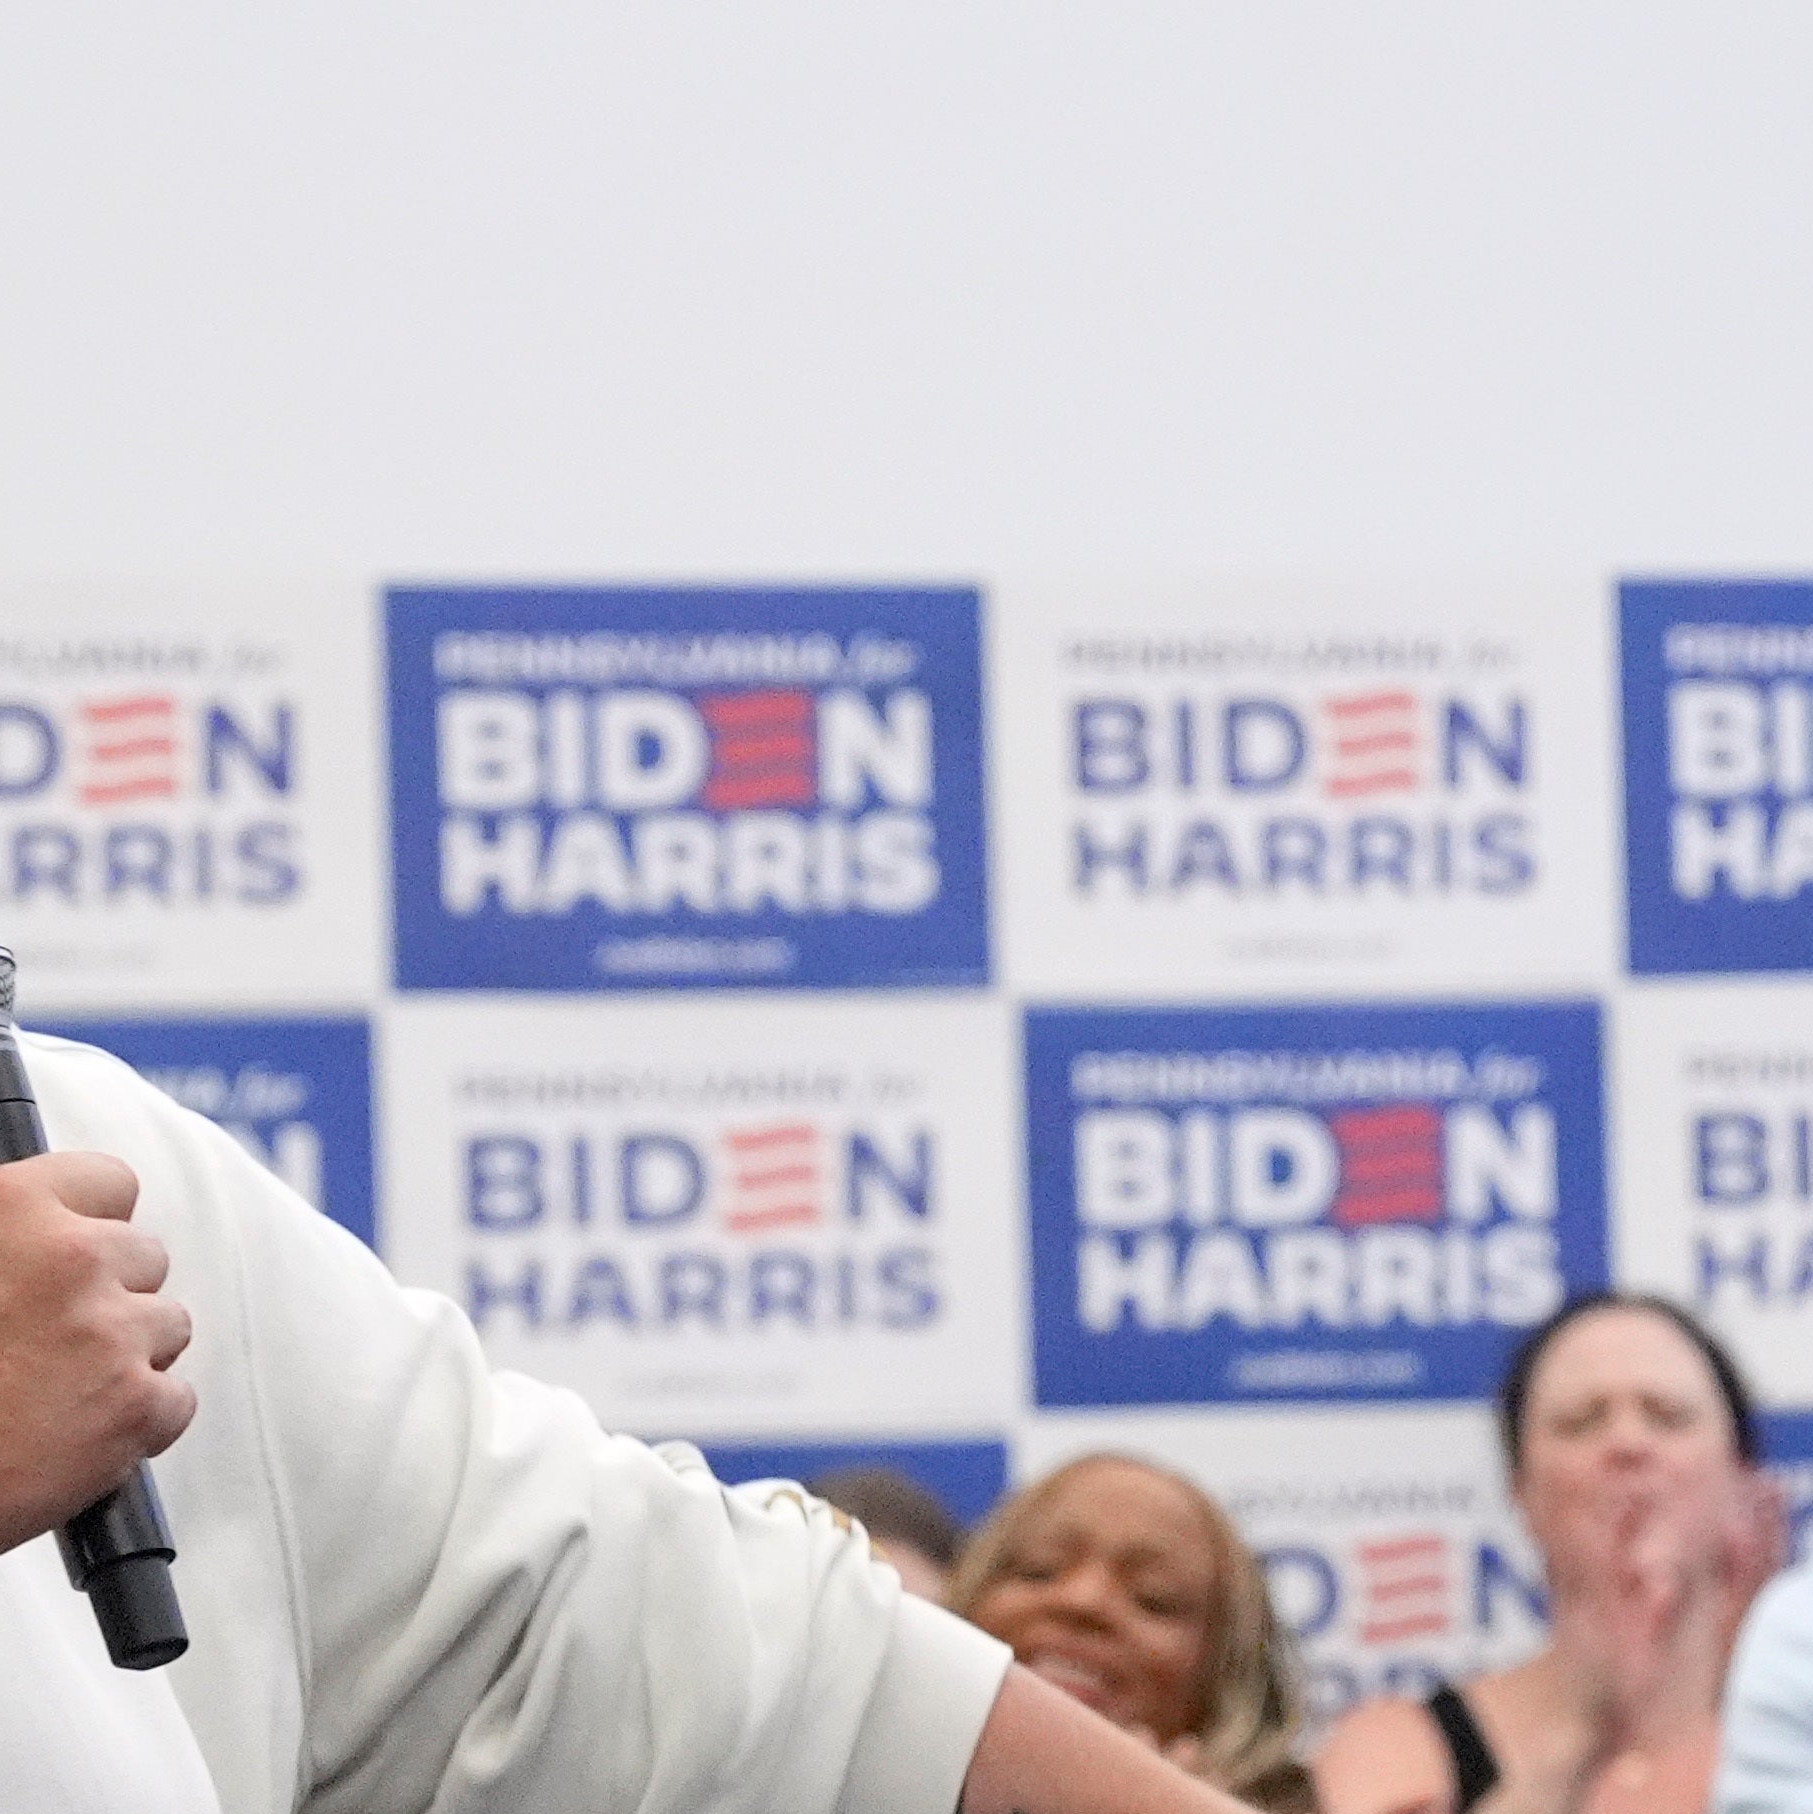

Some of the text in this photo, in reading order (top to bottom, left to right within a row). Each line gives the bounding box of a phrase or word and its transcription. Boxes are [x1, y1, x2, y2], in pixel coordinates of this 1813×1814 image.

[437, 686, 933, 811] BIDEN
[1072, 684, 1527, 796] BIDEN
[441, 810, 941, 916] HARRIS
[1072, 814, 1539, 896] HARRIS
[463, 1124, 938, 1233] BIDEN
[1076, 1101, 1557, 1229] BIDEN
[464, 1247, 944, 1334] HARRIS
[1082, 1224, 1564, 1333] HARRIS
[1258, 1535, 1551, 1647] DEN
